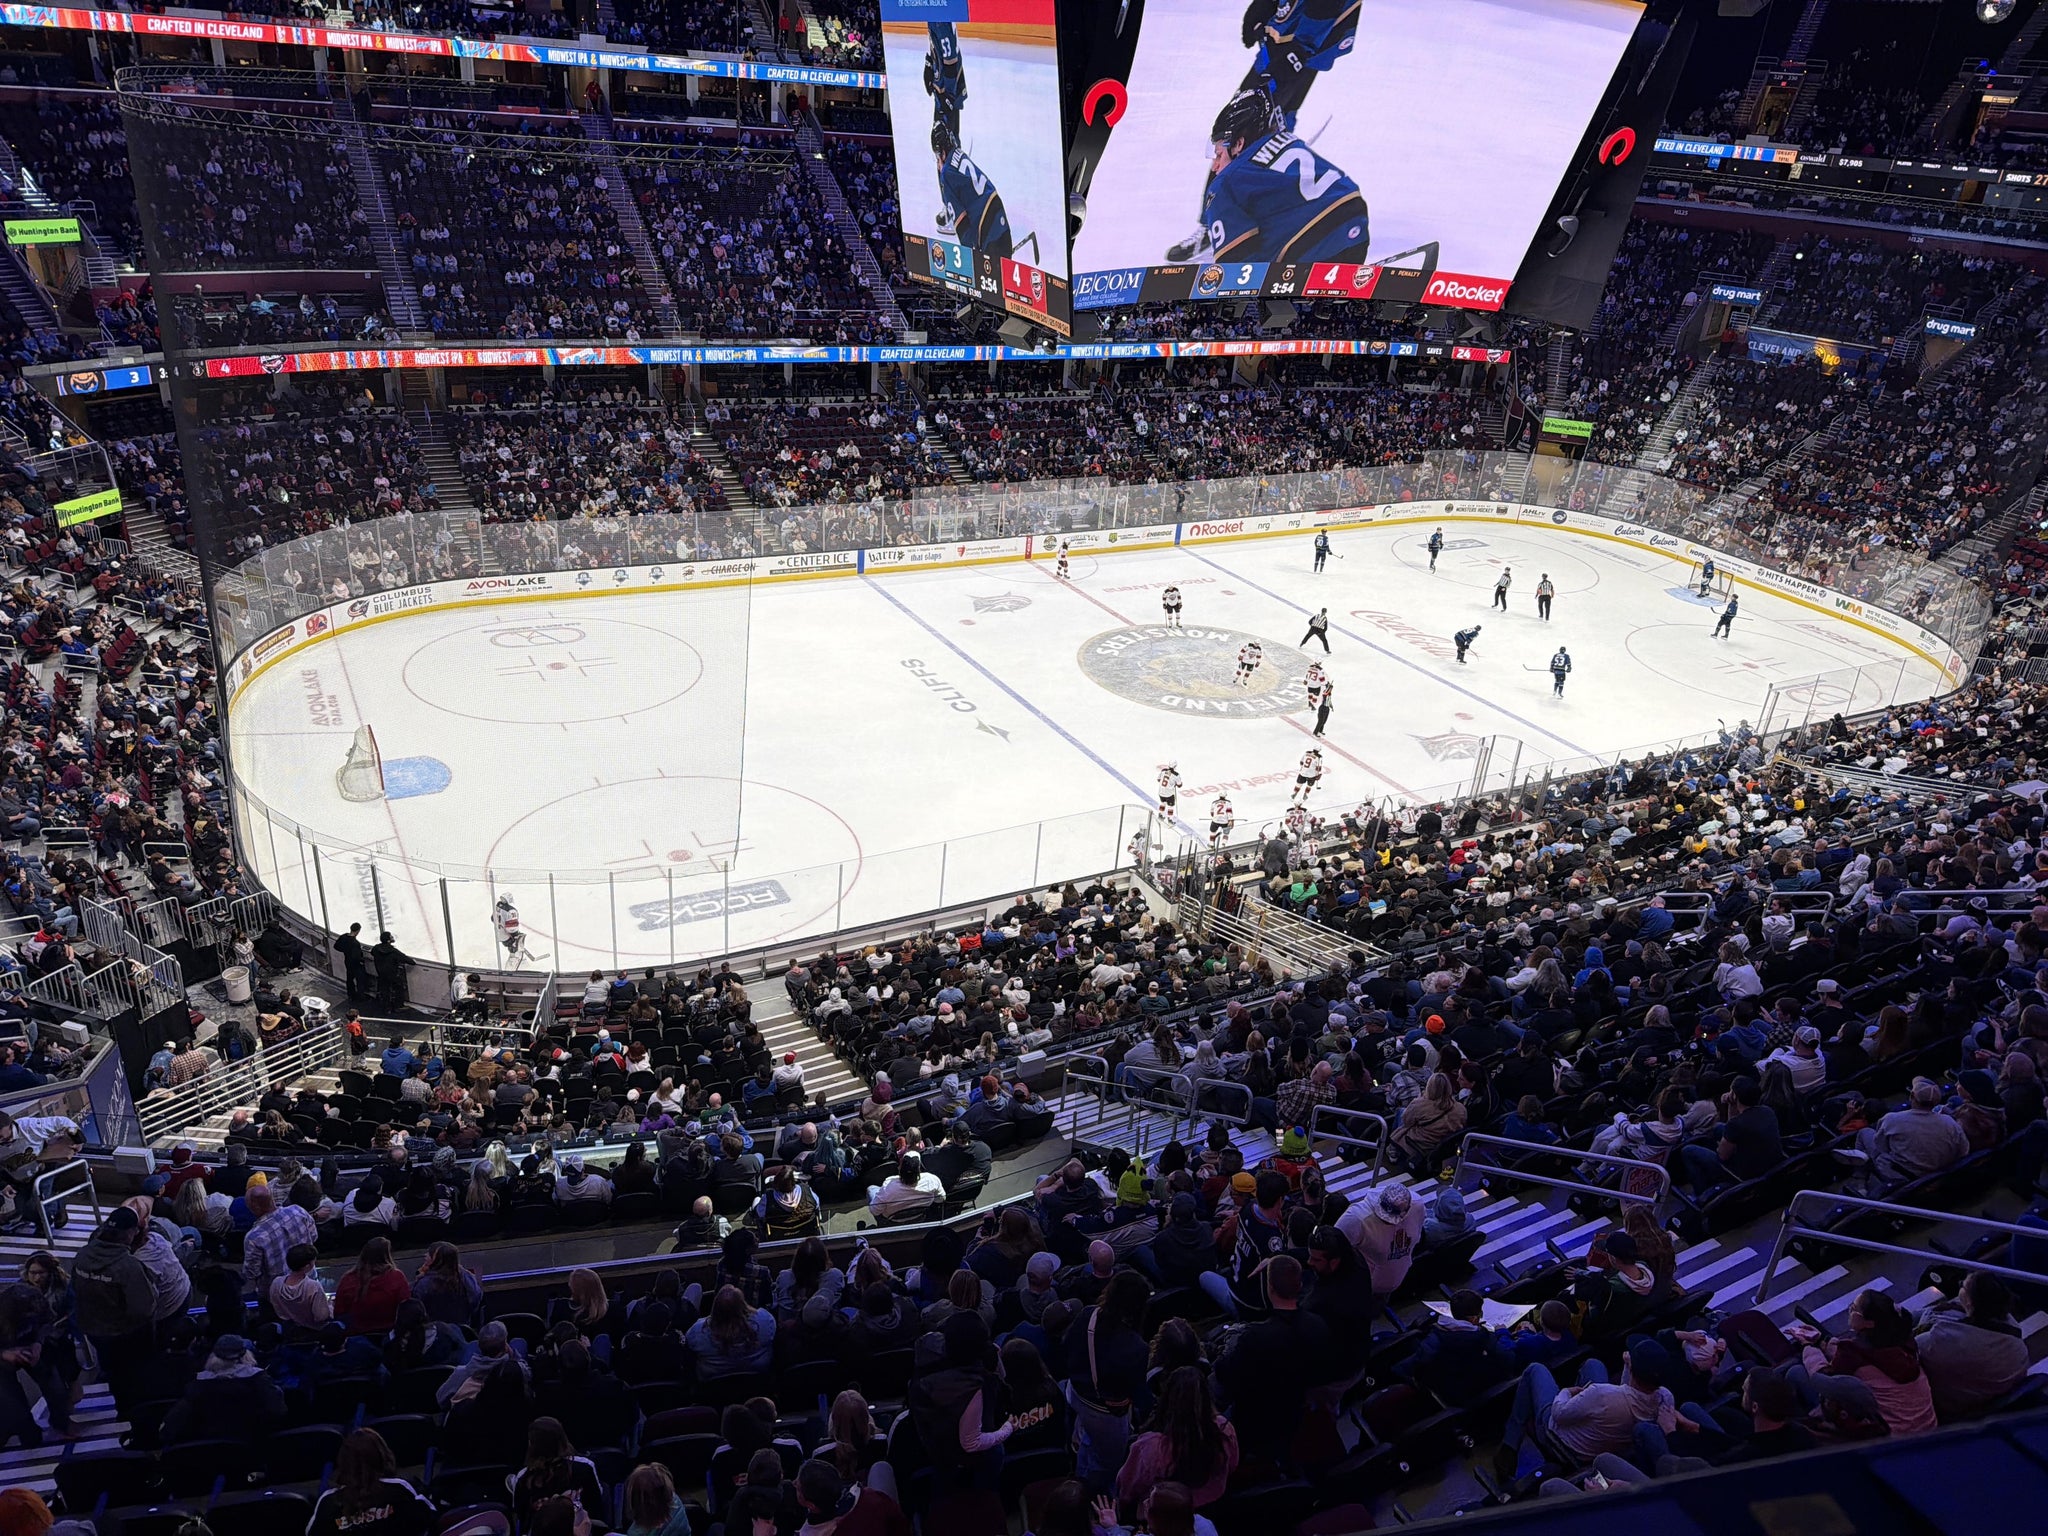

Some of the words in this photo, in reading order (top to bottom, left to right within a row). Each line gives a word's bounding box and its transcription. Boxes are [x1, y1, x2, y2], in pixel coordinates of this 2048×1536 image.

[148, 19, 192, 33] CRAFTED
[194, 22, 205, 34] IN
[207, 23, 263, 39] CLEVELAND
[326, 32, 360, 48] MIDWEST
[360, 35, 373, 48] IPA
[375, 36, 383, 48] &
[548, 49, 577, 64] MIDWEST
[578, 52, 589, 65] IPA
[590, 53, 597, 65] &
[767, 67, 798, 80] CRAFTED
[800, 69, 808, 80] IN
[810, 70, 849, 84] CLEVELAND
[1675, 142, 1683, 151] IN
[1684, 143, 1724, 156] CLEVELAND
[1800, 154, 1827, 163] oswald
[1838, 158, 1863, 168] $7,905
[2005, 173, 2032, 184] SHOTS
[18, 228, 59, 238] Huntington
[60, 226, 78, 235] Bank
[953, 245, 963, 269] 3
[1012, 264, 1021, 288] 4
[1161, 267, 1186, 275] PENALTY
[1237, 264, 1253, 285] 3
[1324, 265, 1340, 284] 4
[1398, 270, 1421, 278] PENALTY
[980, 275, 998, 295] 3:54
[1270, 283, 1295, 294] 3:54
[1445, 281, 1504, 304] Rocket
[1712, 286, 1736, 300] drug
[1736, 291, 1762, 301] mart
[1926, 319, 1950, 335] drug
[1950, 324, 1976, 338] mart
[650, 349, 681, 362] MIDWEST
[682, 349, 693, 362] IPA
[695, 349, 702, 362] &
[880, 349, 914, 361] CRAFTED
[914, 349, 923, 360] IN
[924, 348, 965, 360] CLEVELAND
[1071, 345, 1094, 357] MIDWEST
[1094, 345, 1102, 357] IPA
[1398, 345, 1413, 355] 20
[1426, 348, 1443, 356] SAVES
[1456, 349, 1471, 359] 24
[1748, 341, 1802, 358] CLEVELAND
[220, 363, 230, 374] 4
[129, 371, 139, 384] 3
[1551, 423, 1578, 432] Huntington
[103, 496, 120, 508] Bank
[1201, 520, 1245, 537] Rocket
[1257, 523, 1272, 533] nrg
[1287, 519, 1301, 530] nrg
[1614, 524, 1647, 537] Culver's
[1146, 530, 1173, 539] ENBRIDGE
[1649, 534, 1680, 548] Culver's
[786, 554, 831, 568] CENTER
[832, 552, 851, 565] ICE
[910, 553, 925, 565] that
[926, 551, 943, 564] slaps
[711, 563, 743, 576] CHARGE
[467, 576, 547, 591] AVONLAKE
[1764, 571, 1784, 585] HITS
[1785, 577, 1818, 596] HAPPEN
[372, 586, 432, 604] COLUMBUS
[1804, 591, 1820, 604] SMITH
[373, 600, 396, 615] BLUE
[397, 593, 434, 610] JACKETS
[1834, 597, 1863, 616] WM
[1882, 614, 1899, 627] DRIVING
[1096, 628, 1232, 657] MONSTERS
[1553, 655, 1566, 666] 53
[1307, 670, 1318, 682] 73
[899, 657, 977, 713] CLIFFS
[301, 668, 330, 727] AVONLAKE
[1303, 757, 1312, 769] 9
[1161, 775, 1170, 788] 6
[1180, 780, 1242, 798] Arena
[1216, 804, 1225, 816] 2
[1290, 814, 1304, 827] 24
